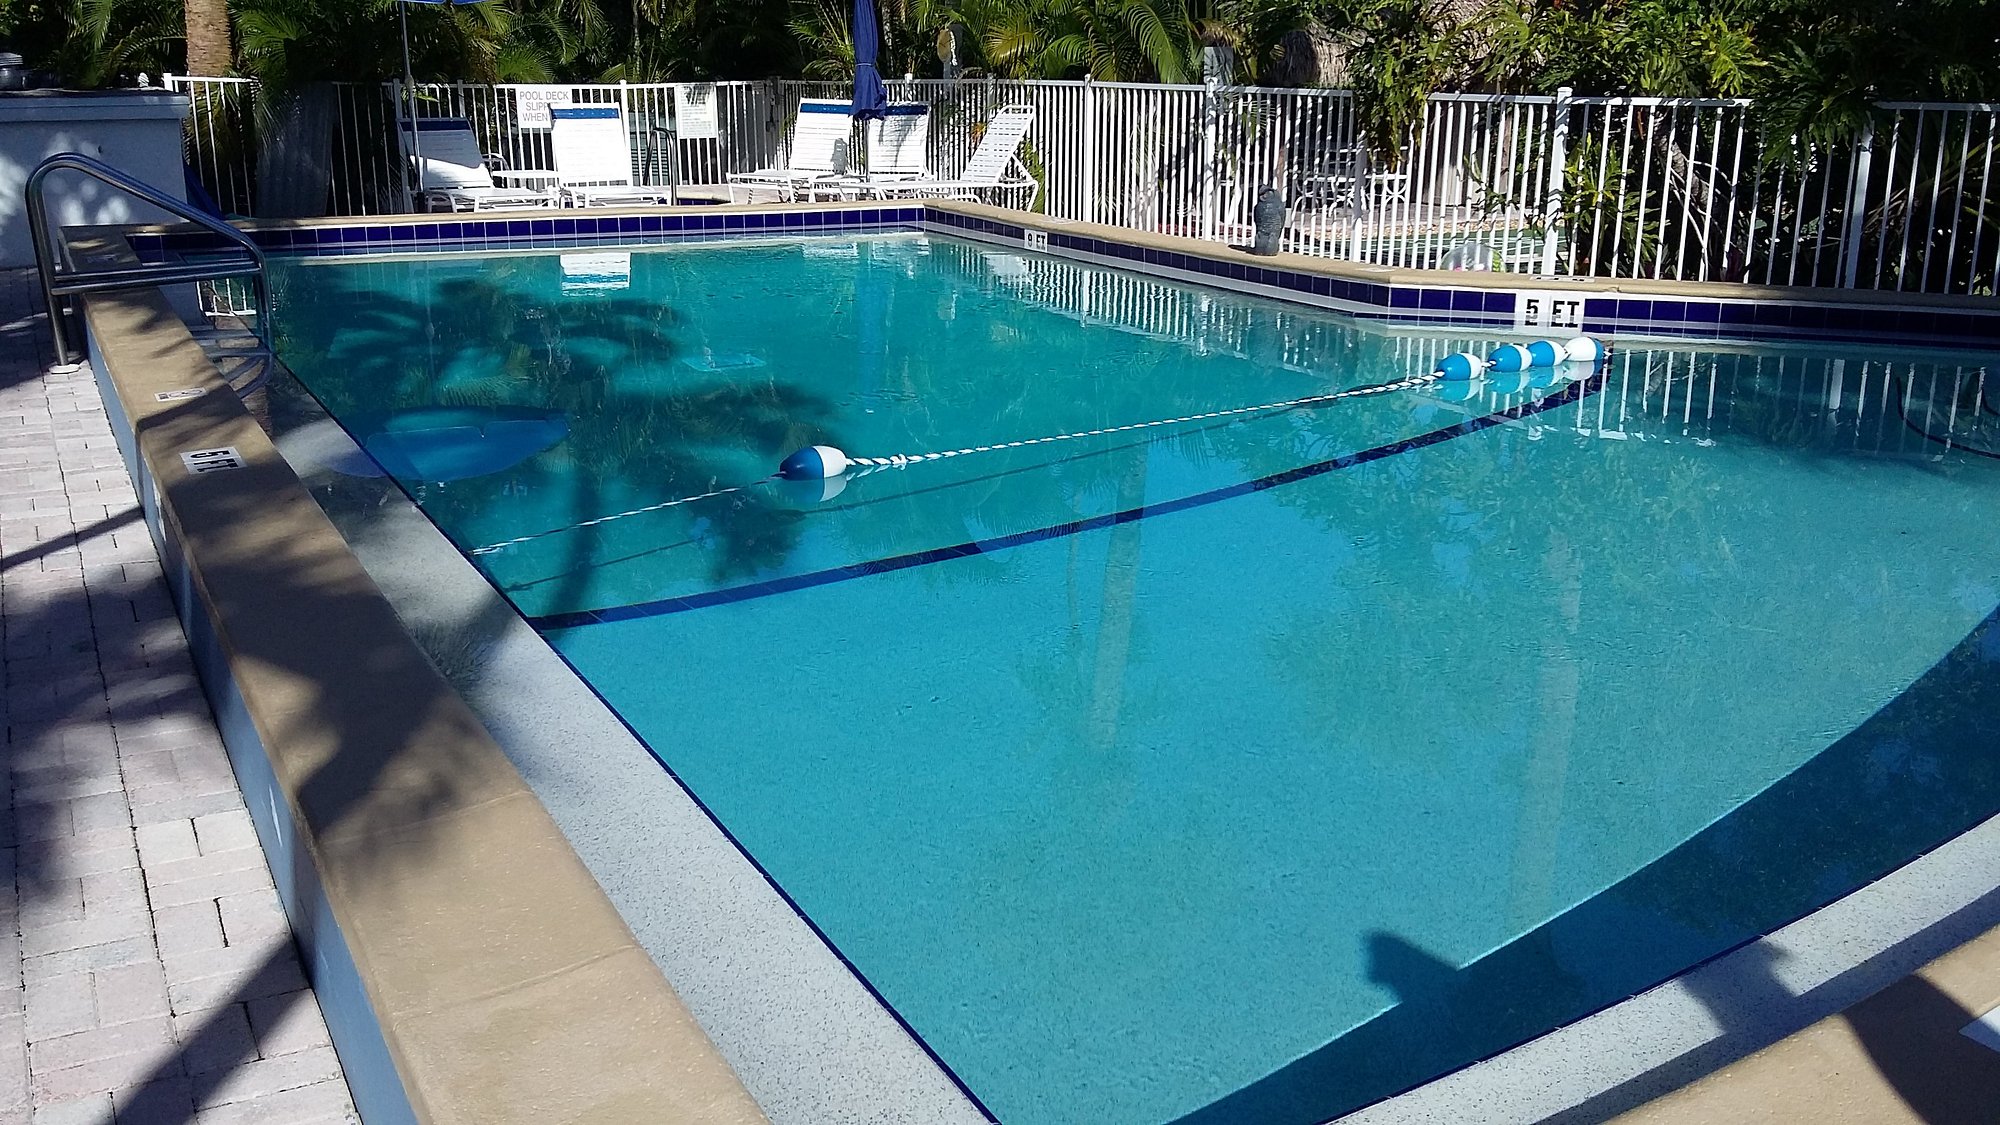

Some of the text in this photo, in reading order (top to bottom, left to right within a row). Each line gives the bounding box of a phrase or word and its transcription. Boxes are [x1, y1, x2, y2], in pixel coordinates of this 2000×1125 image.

[519, 91, 569, 101] POOL DECK
[525, 101, 559, 111] SLIPP
[522, 112, 548, 121] WHEN
[1525, 299, 1539, 325] 5
[190, 450, 239, 473] 5 FT
